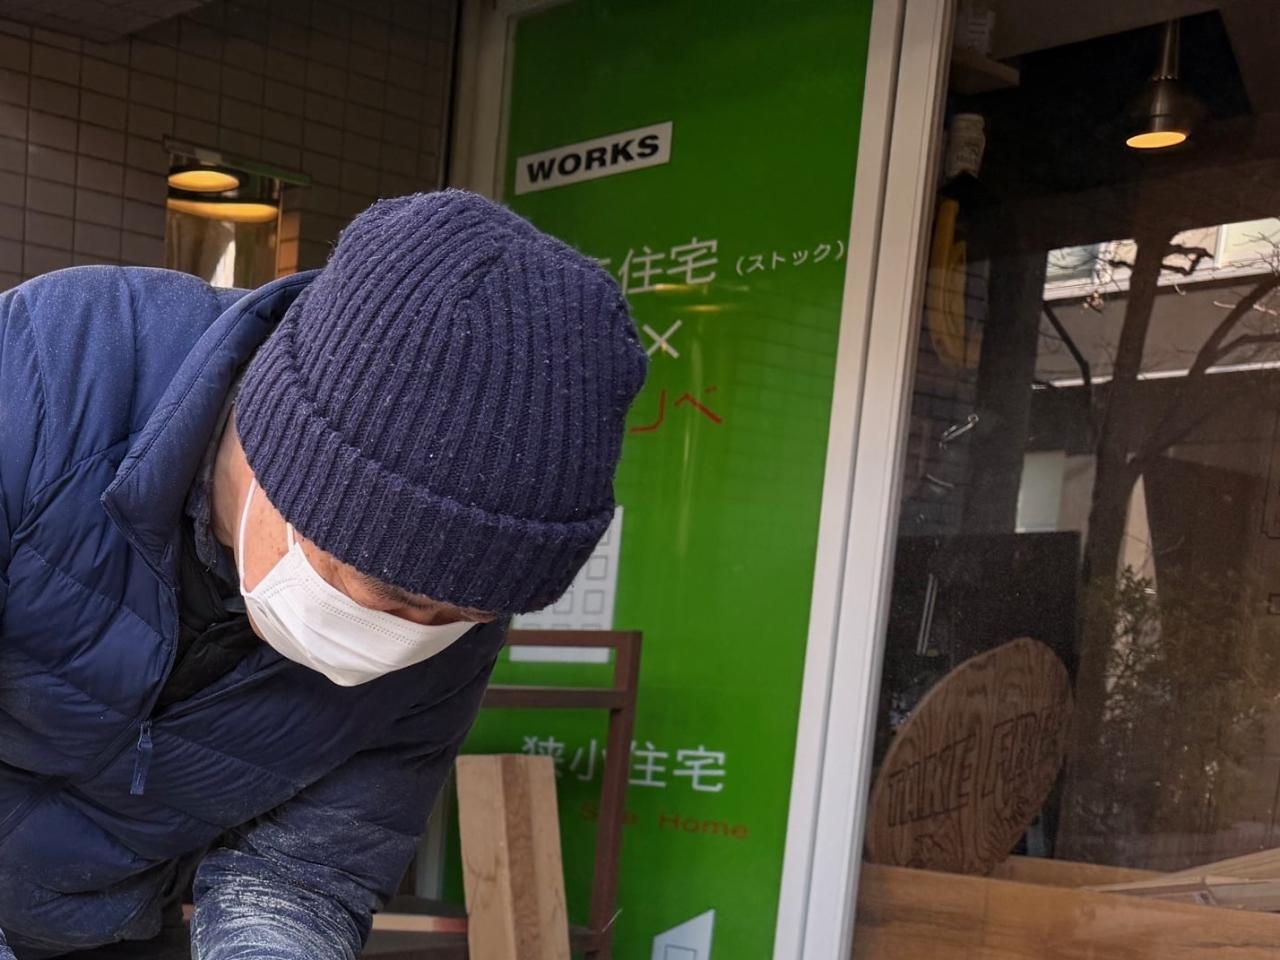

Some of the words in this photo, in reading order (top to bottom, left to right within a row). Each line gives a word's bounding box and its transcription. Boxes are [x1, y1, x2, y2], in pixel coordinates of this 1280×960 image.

[527, 134, 660, 184] WORKS
[597, 237, 718, 294] 住宅
[658, 813, 750, 841] Home
